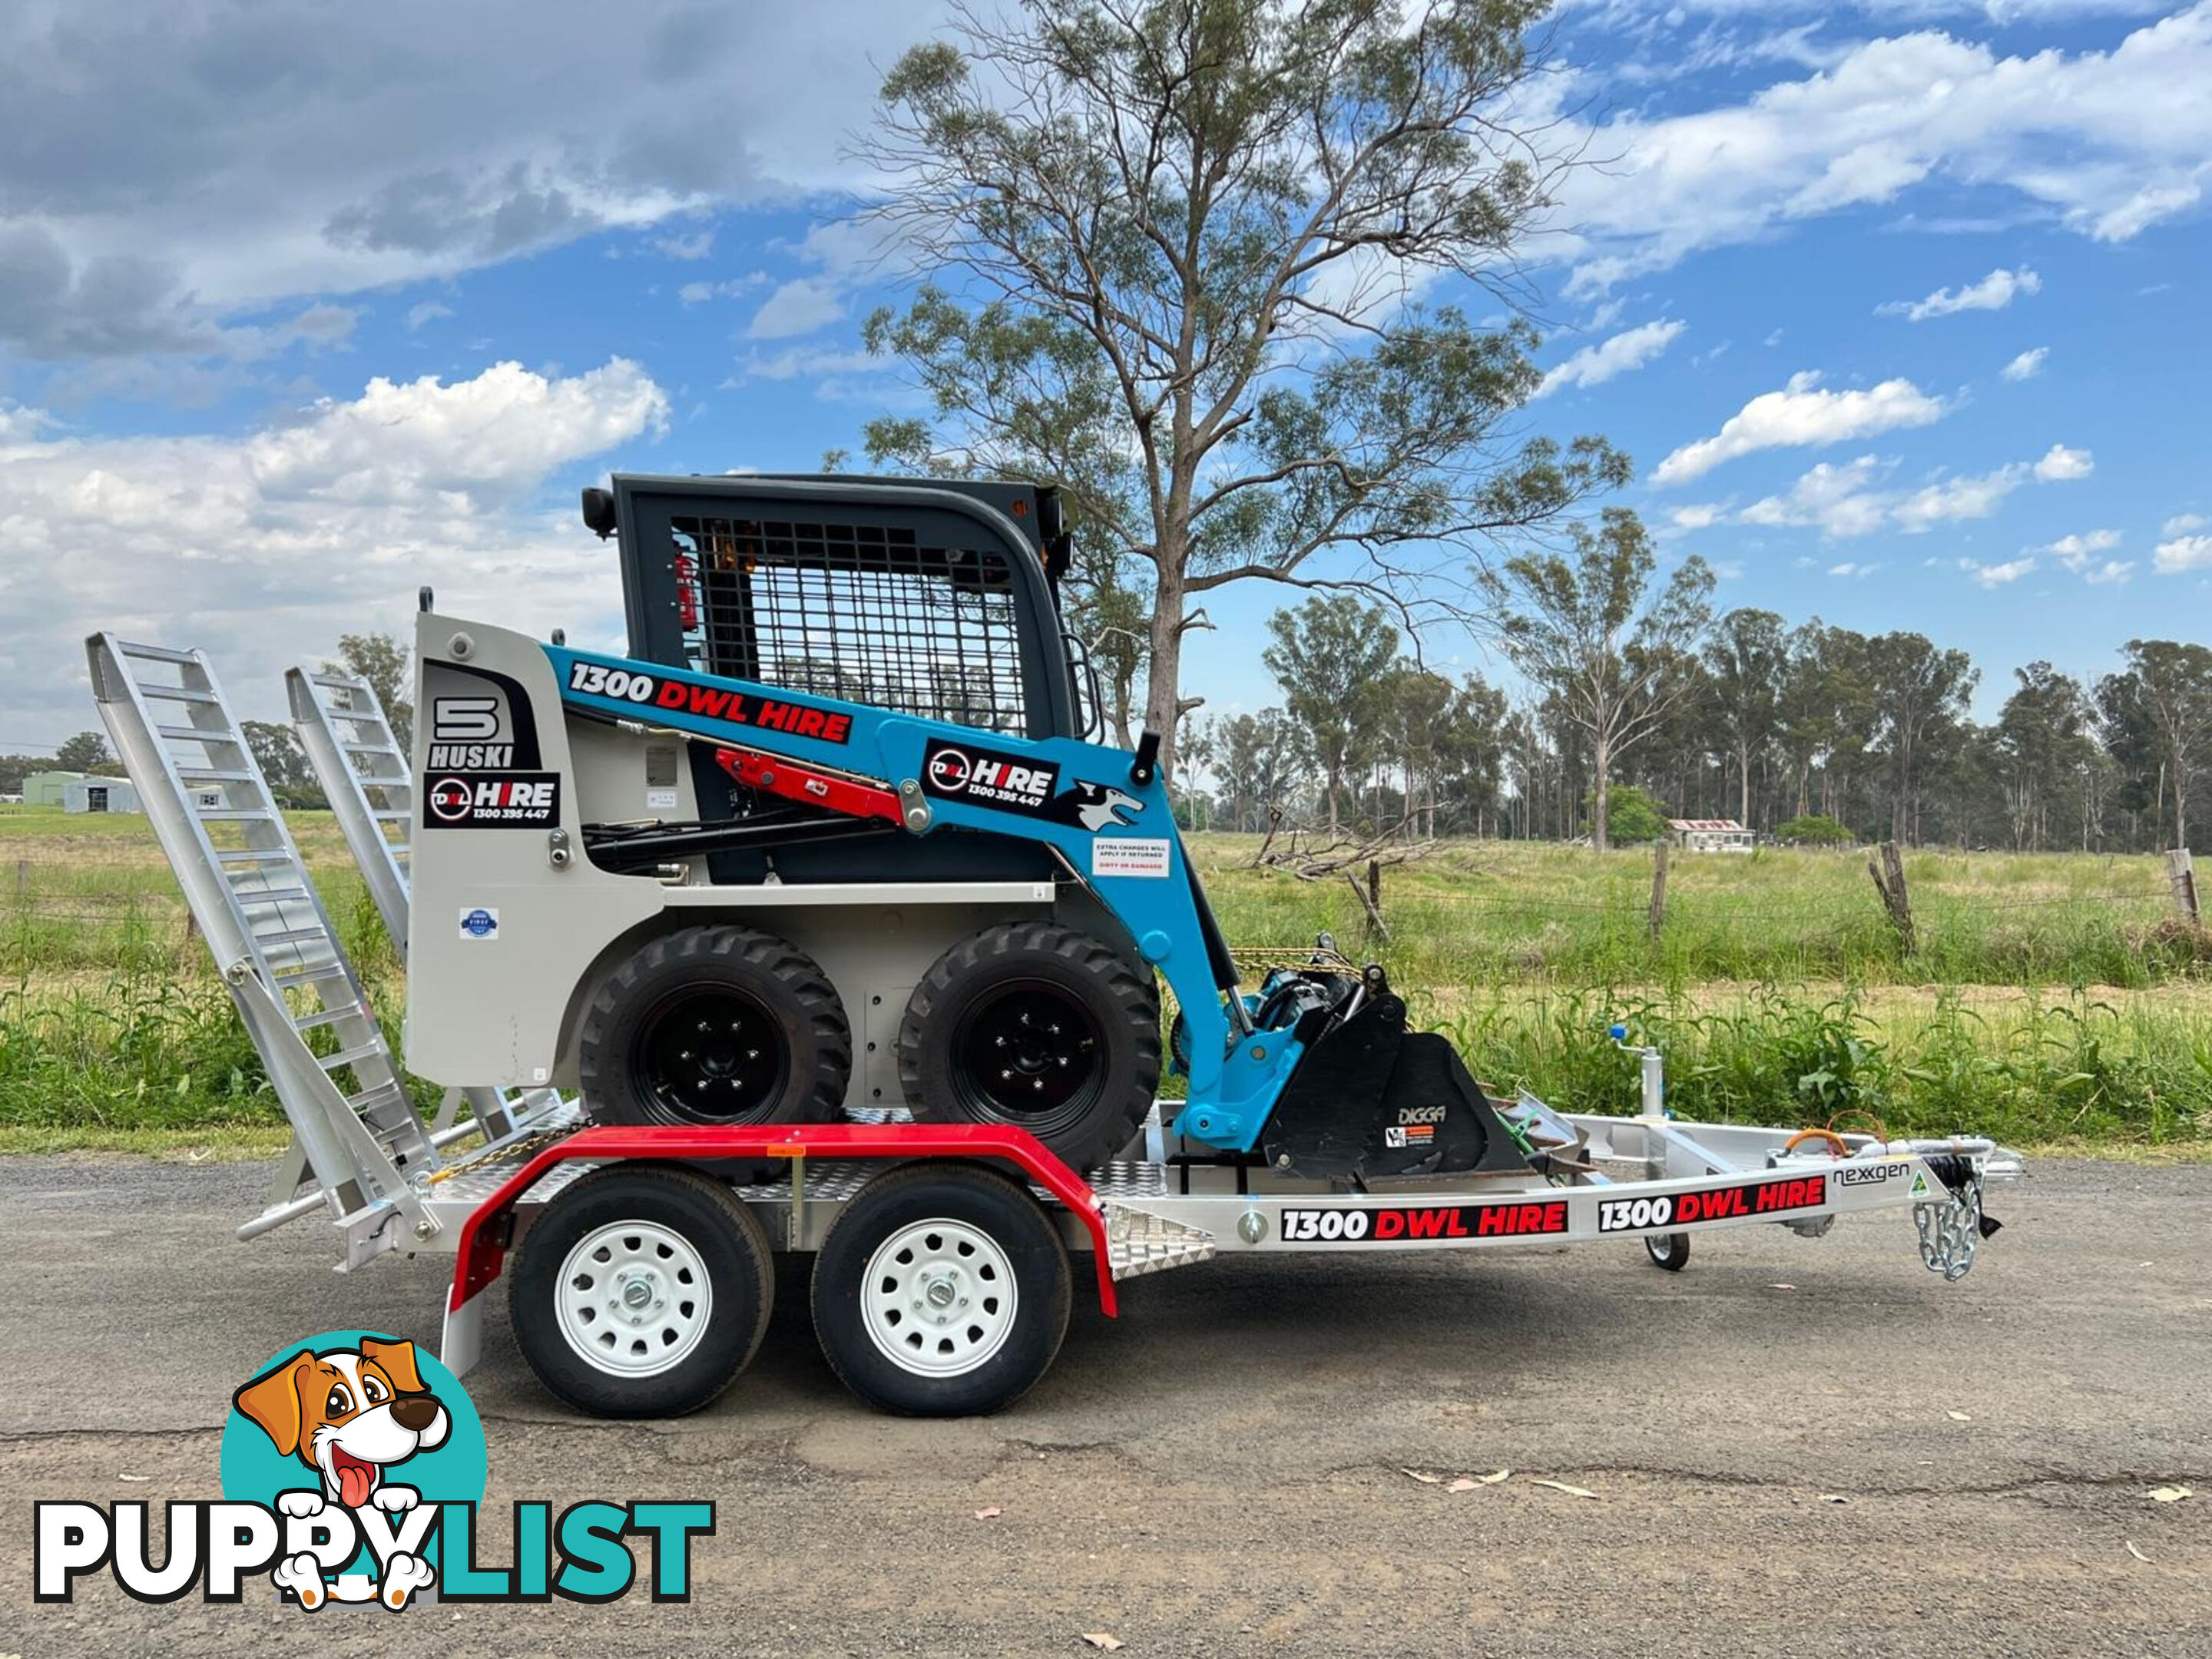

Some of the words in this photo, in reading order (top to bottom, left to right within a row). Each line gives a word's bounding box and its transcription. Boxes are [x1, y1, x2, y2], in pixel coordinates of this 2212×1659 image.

[571, 664, 654, 703] 1300
[656, 680, 748, 722] DWL
[756, 701, 849, 742] HIRE
[429, 745, 514, 768] HUSKI
[971, 759, 1053, 796] HIRE
[431, 793, 472, 806] DWL
[474, 782, 555, 806] HIRE
[968, 783, 995, 798] 1300
[995, 789, 1018, 803] 395
[1018, 794, 1044, 806] 447
[473, 809, 500, 818] 1300
[502, 810, 523, 818] 395
[525, 810, 549, 819] 447
[1398, 1106, 1446, 1125] DIGGA
[1833, 1164, 1910, 1187] nexxgen
[1600, 1200, 1672, 1230] 1300
[1676, 1190, 1749, 1223] DWL
[1757, 1177, 1824, 1212] HIRE
[1283, 1210, 1369, 1240] 1300
[1374, 1210, 1468, 1239] DWL
[1478, 1204, 1565, 1236] HIRE
